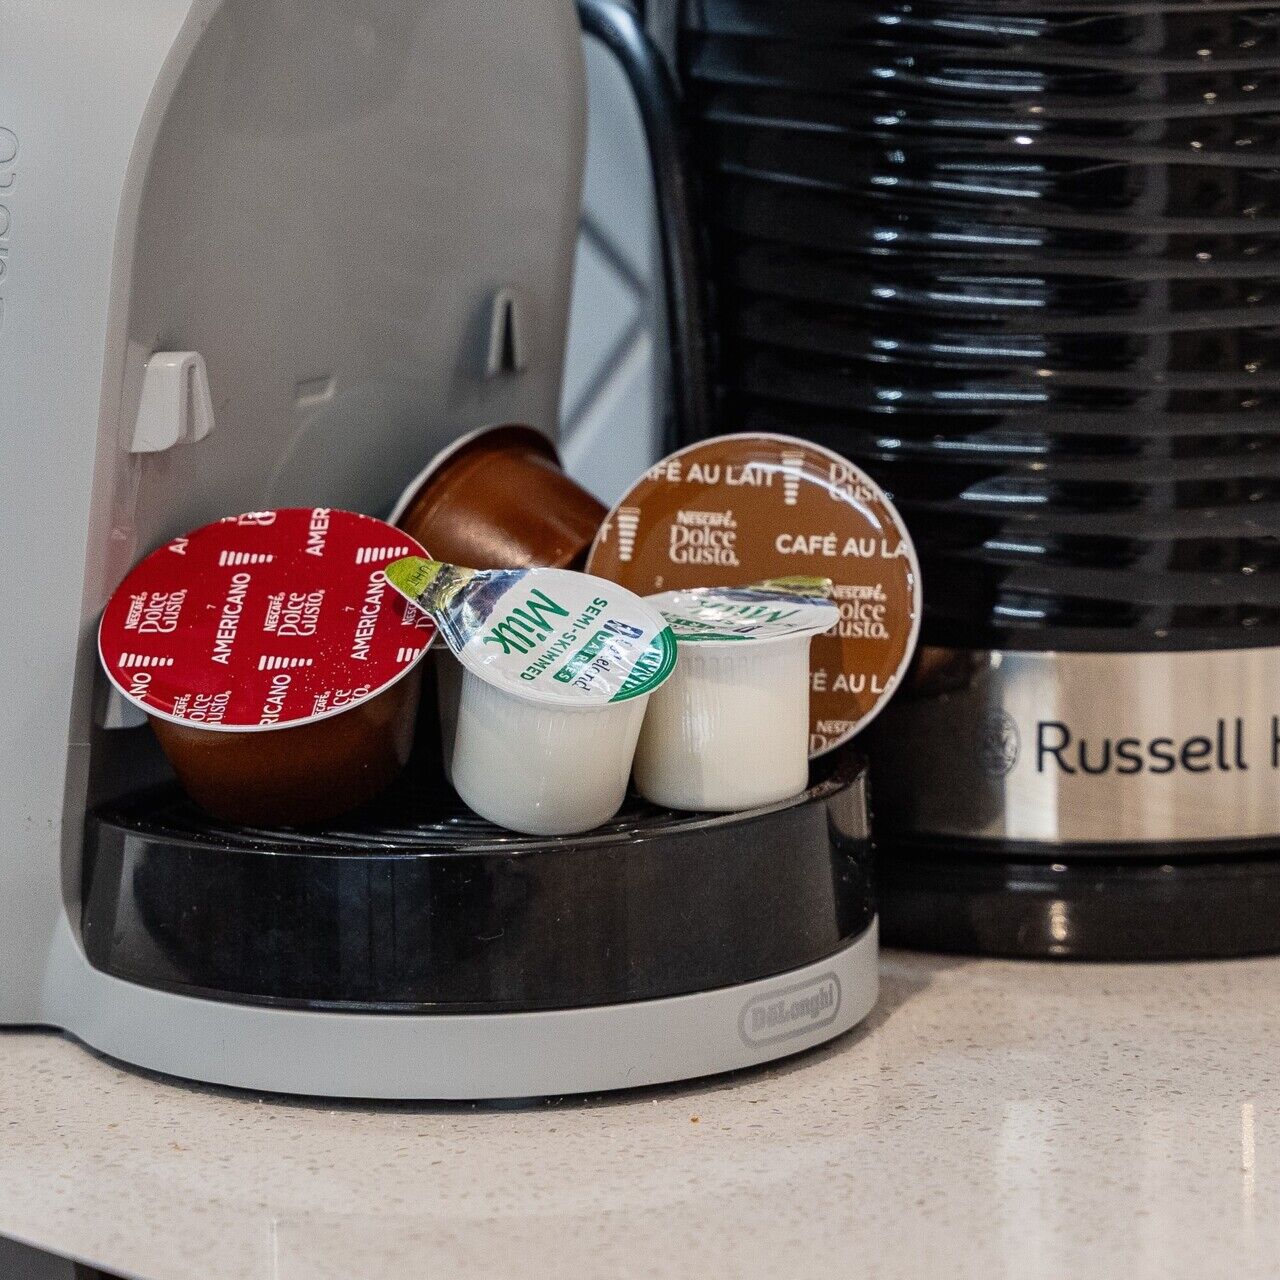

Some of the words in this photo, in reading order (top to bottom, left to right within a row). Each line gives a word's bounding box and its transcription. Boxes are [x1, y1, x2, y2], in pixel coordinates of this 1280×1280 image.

[686, 463, 720, 485] AU
[671, 524, 737, 549] Dolce
[775, 531, 838, 557] CAFÉ
[842, 537, 876, 558] AU
[138, 592, 169, 634] Dolce
[211, 573, 252, 665] AMERICANO
[277, 592, 307, 637] Dolce
[350, 570, 386, 661] AMERICANO
[483, 588, 570, 655] Milk
[840, 599, 887, 622] olce
[520, 597, 609, 681] SEMI-SKIMMED
[832, 673, 866, 694] AU
[1036, 717, 1247, 776] Russell
